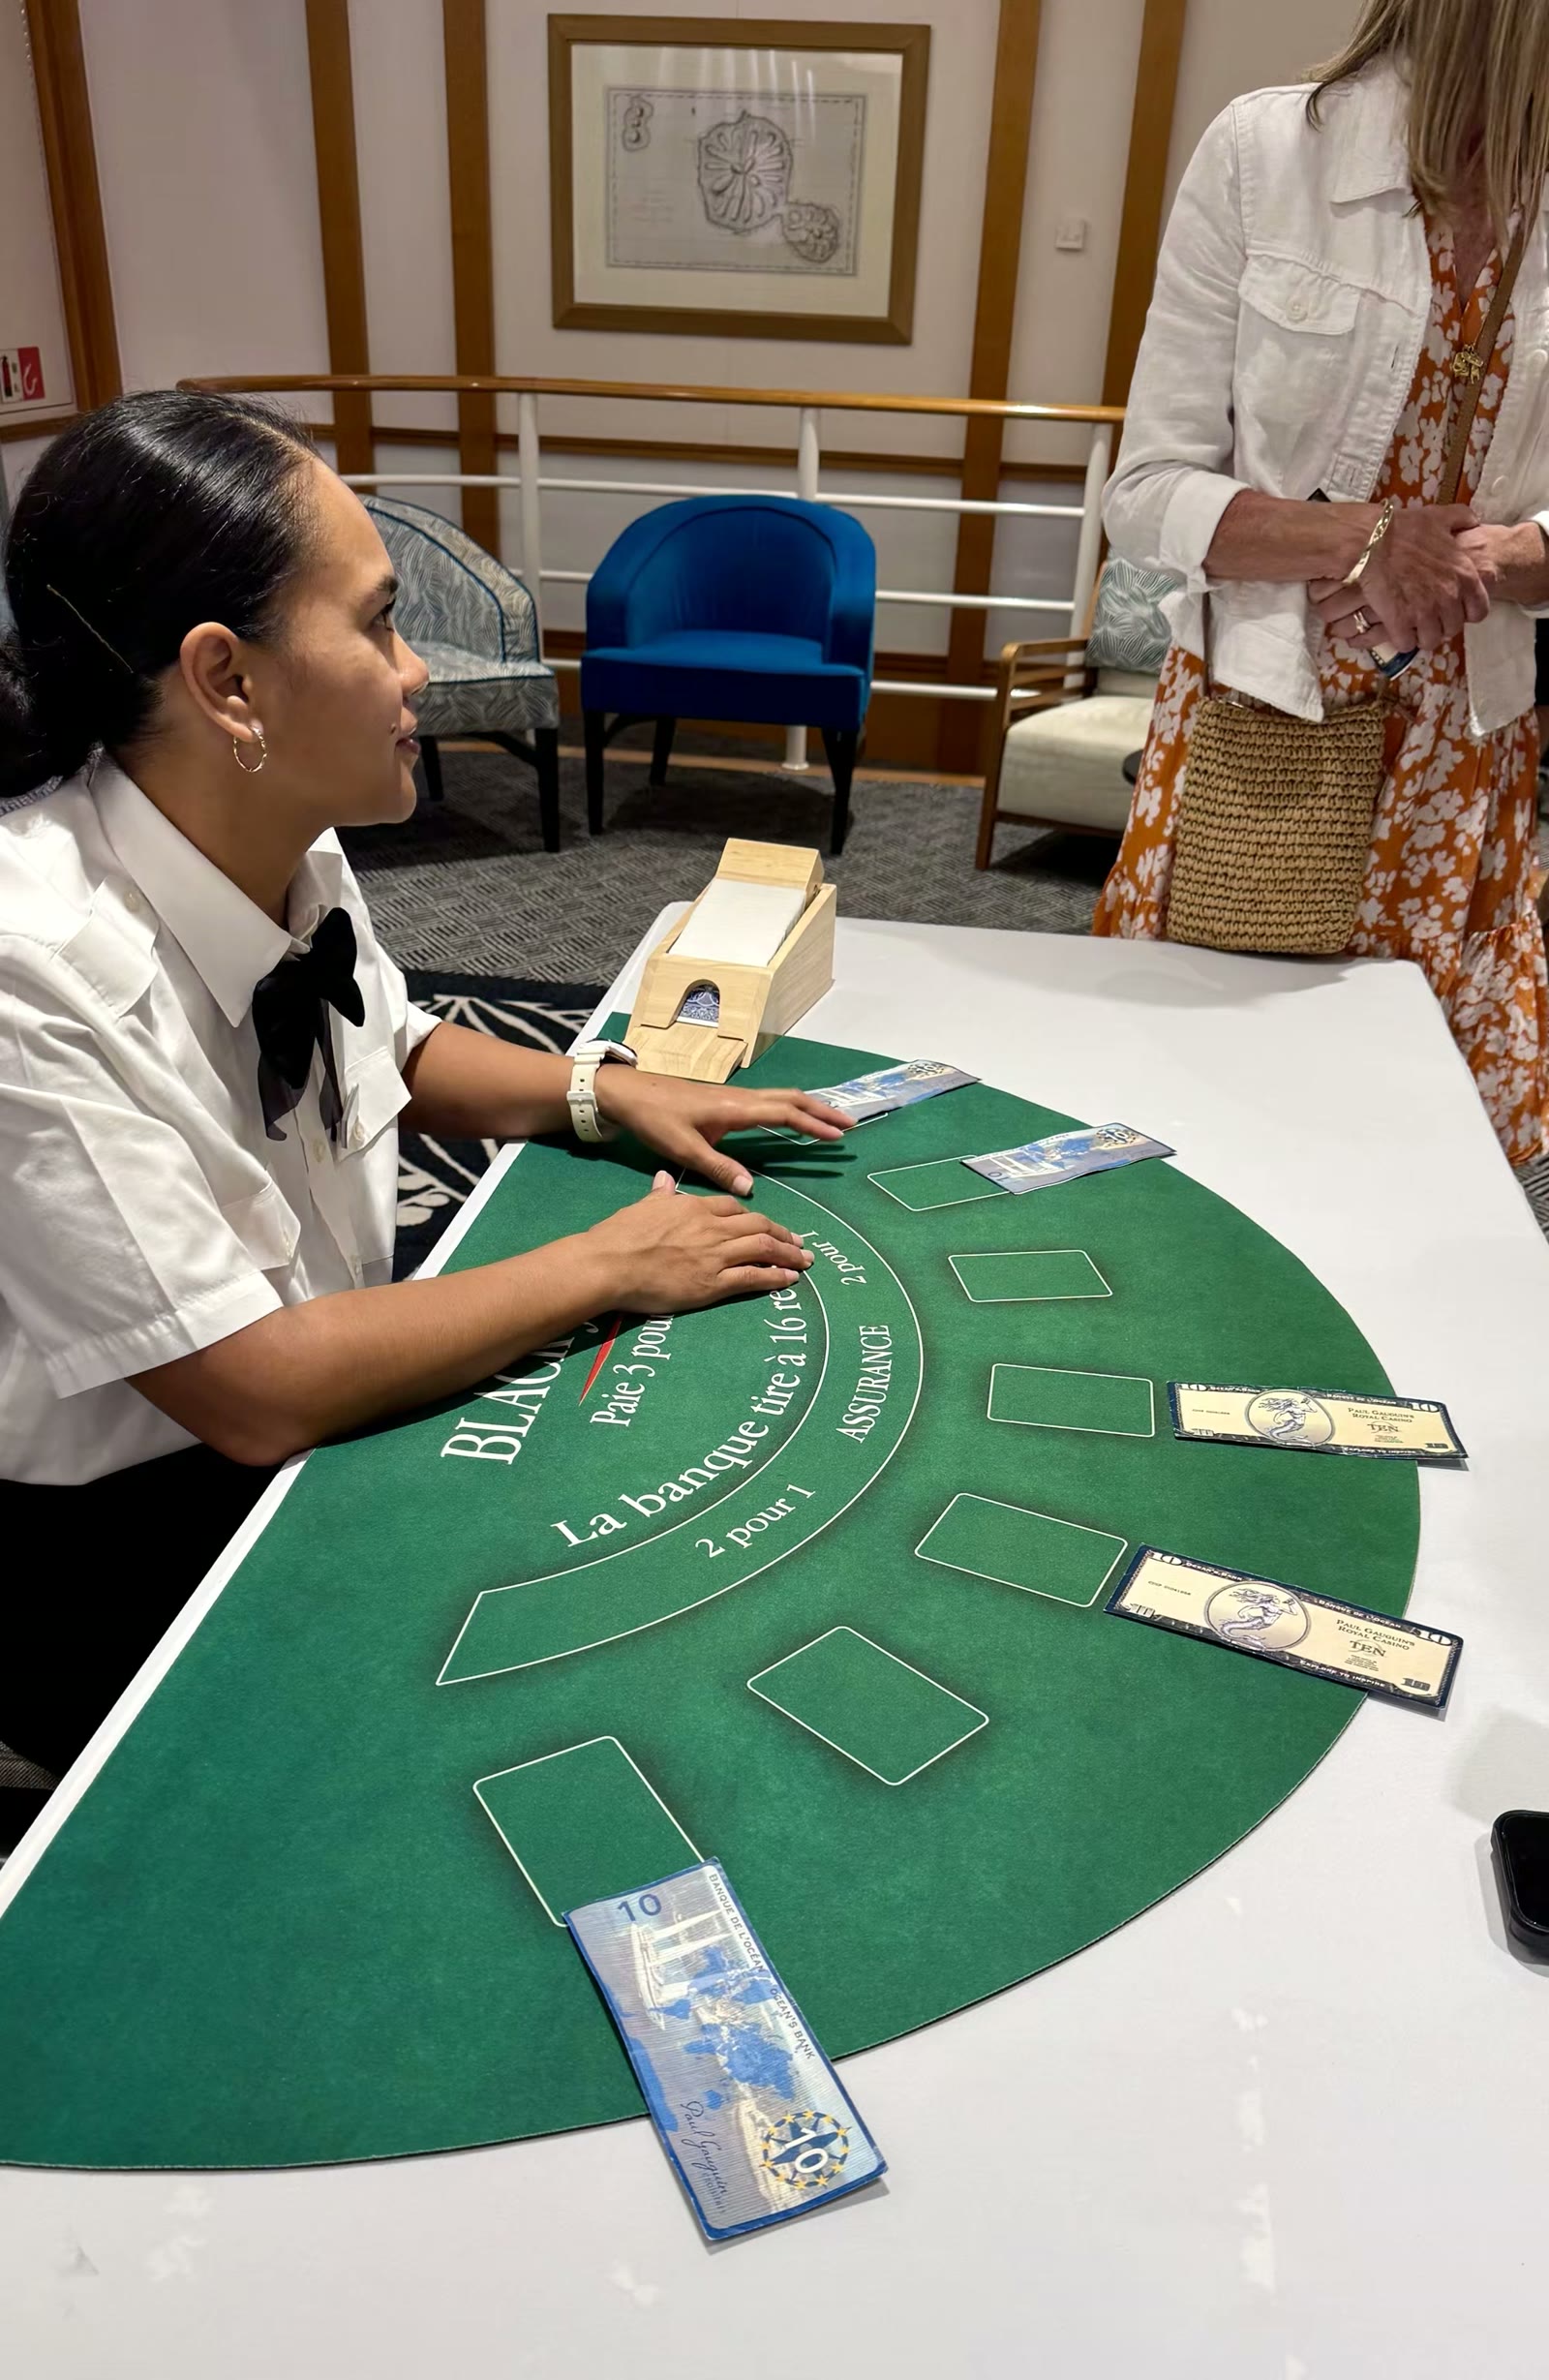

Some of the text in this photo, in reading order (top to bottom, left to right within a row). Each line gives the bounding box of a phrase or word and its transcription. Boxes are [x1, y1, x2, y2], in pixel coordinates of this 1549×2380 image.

[1106, 1131, 1128, 1141] 10
[812, 1241, 866, 1272] pour
[840, 1275, 867, 1285] 2
[590, 1314, 674, 1427] Paie 3 pou
[835, 1325, 893, 1443] ASSURANCE
[550, 1287, 806, 1547] La banque tire à 16 re
[1412, 1402, 1441, 1413] 10
[1367, 1423, 1399, 1433] TEN
[695, 1483, 815, 1558] 2 pour 1
[1152, 1551, 1182, 1566] 10
[1336, 1619, 1415, 1647] PAUL GAUGUIN'S
[1338, 1626, 1411, 1650] ROYAL CASINO
[1417, 1628, 1452, 1646] 10
[1349, 1640, 1386, 1657] TEN
[618, 1893, 662, 1922] 10
[709, 1873, 735, 1914] BANQUE
[731, 1916, 743, 1931] DE
[770, 1988, 816, 2060] OCEAN'S BANK
[784, 2127, 829, 2173] 10
